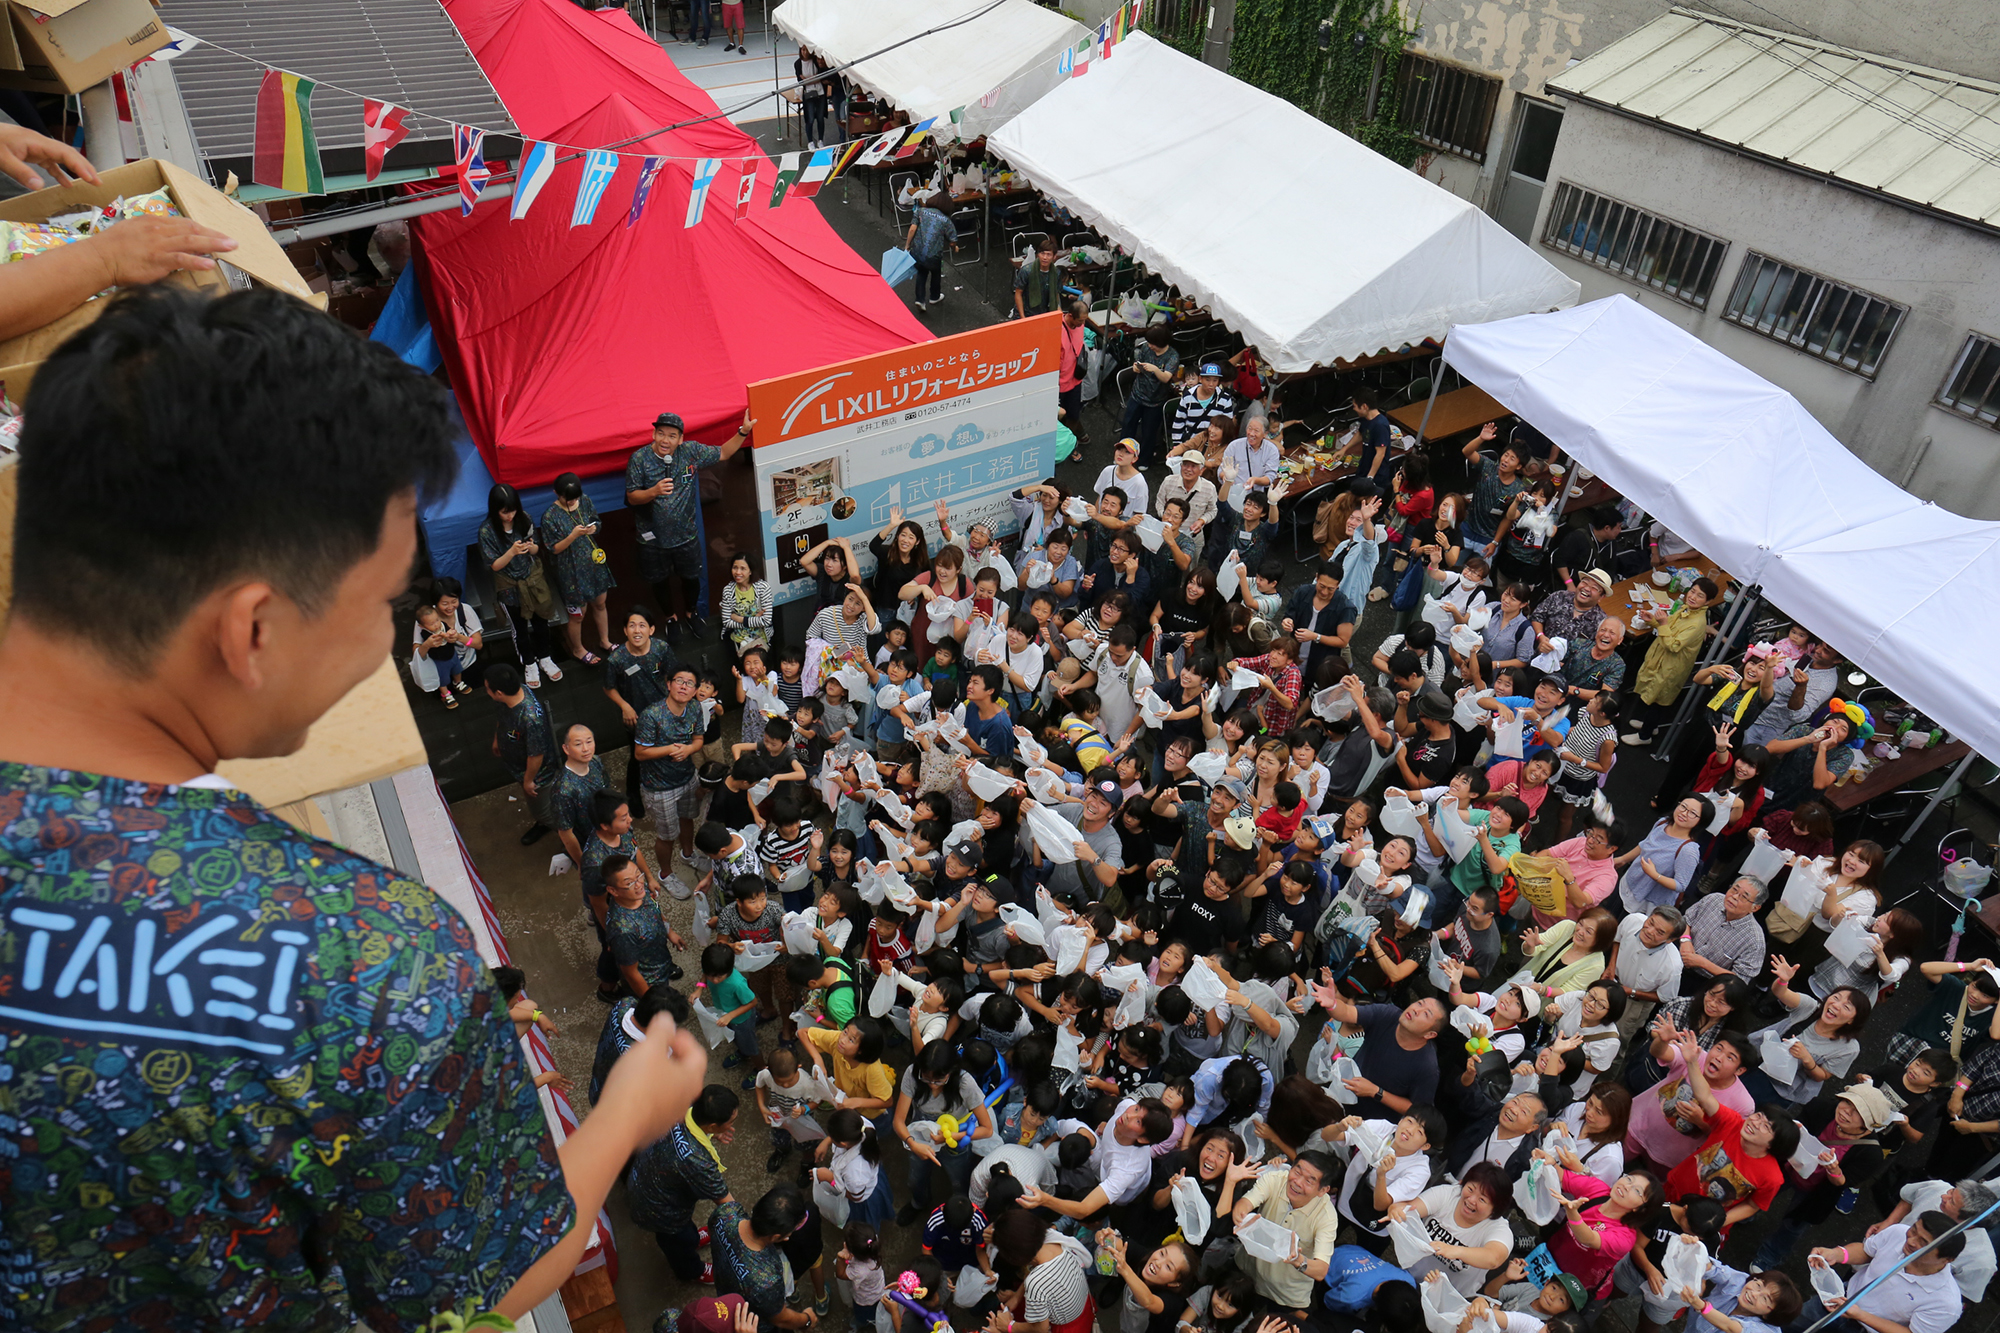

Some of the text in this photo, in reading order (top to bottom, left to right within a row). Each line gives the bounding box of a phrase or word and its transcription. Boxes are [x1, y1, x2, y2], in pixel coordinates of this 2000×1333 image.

[885, 349, 981, 382] 住まいのことなら
[820, 348, 1040, 425] LIXILリフォームショップ
[856, 397, 972, 434] 武井工務店 0120-57-4774
[920, 441, 935, 456] 夢
[955, 430, 979, 446] 想い
[906, 446, 1041, 504] 武井工務店
[777, 514, 823, 531] ショールーム
[787, 509, 802, 522] 2F
[1191, 902, 1216, 922] ROXY
[1454, 916, 1473, 960] MARVEL
[10, 907, 310, 1031] TAKEI
[715, 1218, 750, 1281] TEAM TAKEI
